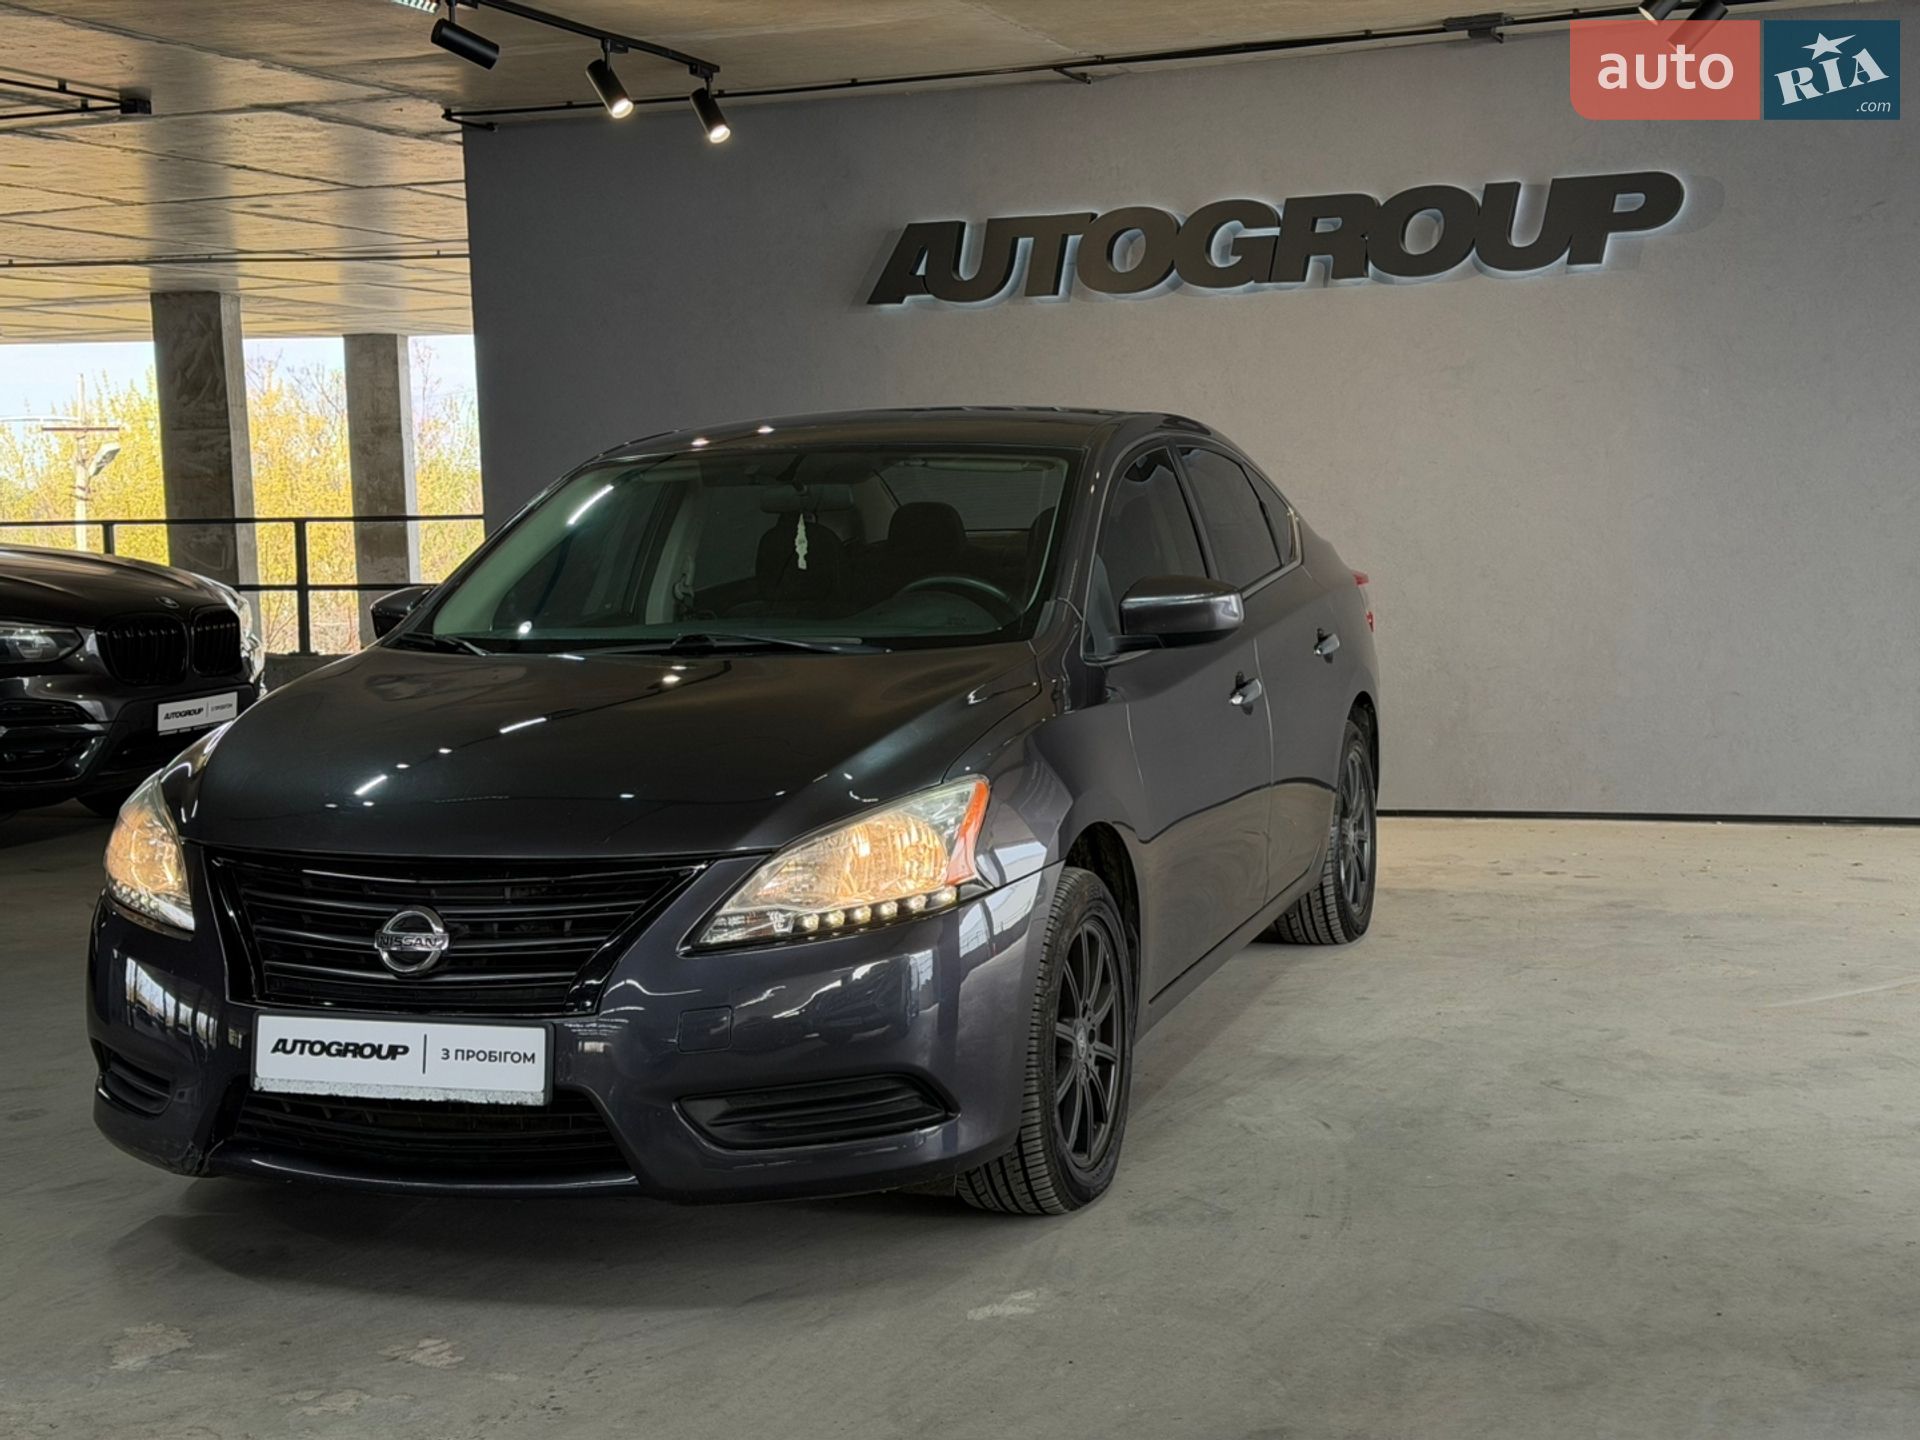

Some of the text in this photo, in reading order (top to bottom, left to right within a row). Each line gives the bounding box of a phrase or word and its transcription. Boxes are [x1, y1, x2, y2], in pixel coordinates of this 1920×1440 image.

[867, 170, 1685, 305] AUTOGROUP
[164, 707, 204, 720] AUTOGROUP
[380, 935, 442, 948] NISSAN
[271, 1038, 410, 1061] AUTOGROUP
[455, 1049, 536, 1064] ПРОБІГОМ
